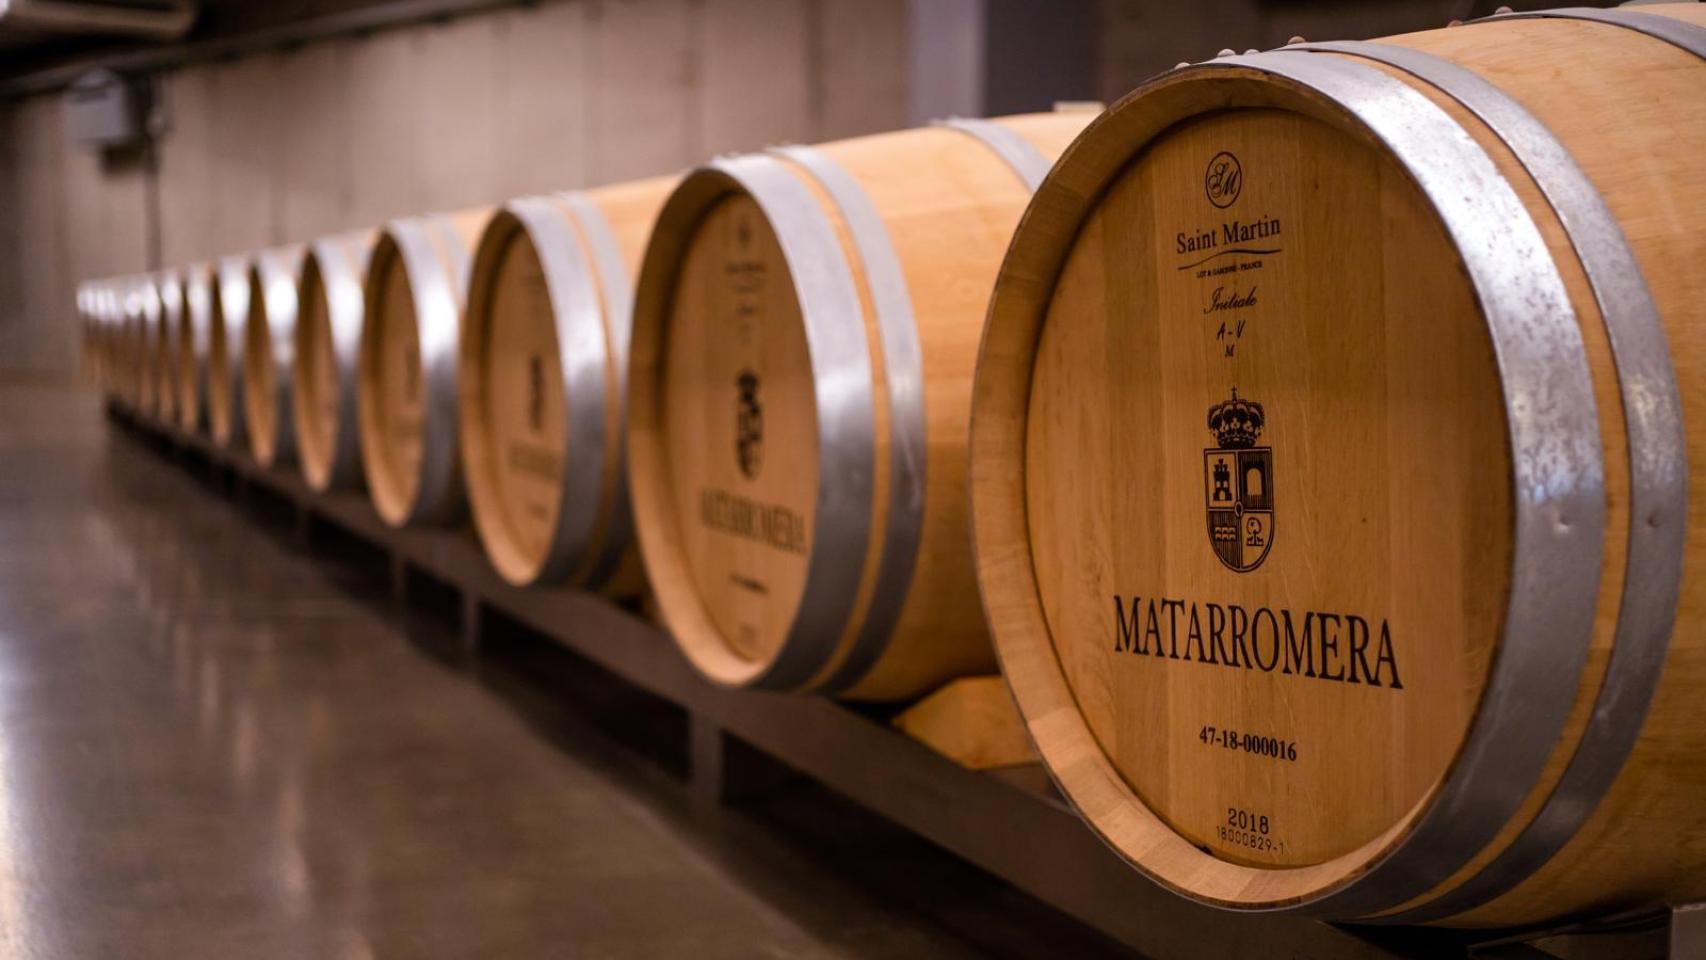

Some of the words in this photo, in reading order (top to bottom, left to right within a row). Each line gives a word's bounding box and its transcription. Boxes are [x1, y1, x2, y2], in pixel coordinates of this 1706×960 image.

[1176, 229, 1217, 254] Saint
[1222, 214, 1280, 245] Martin
[1203, 286, 1257, 314] Initiale
[1225, 344, 1235, 358] M
[1113, 595, 1404, 690] MATARROMERA
[1199, 726, 1297, 761] 47-18-000016
[1228, 807, 1269, 835] 2018
[1216, 825, 1284, 856] 18000829-1
